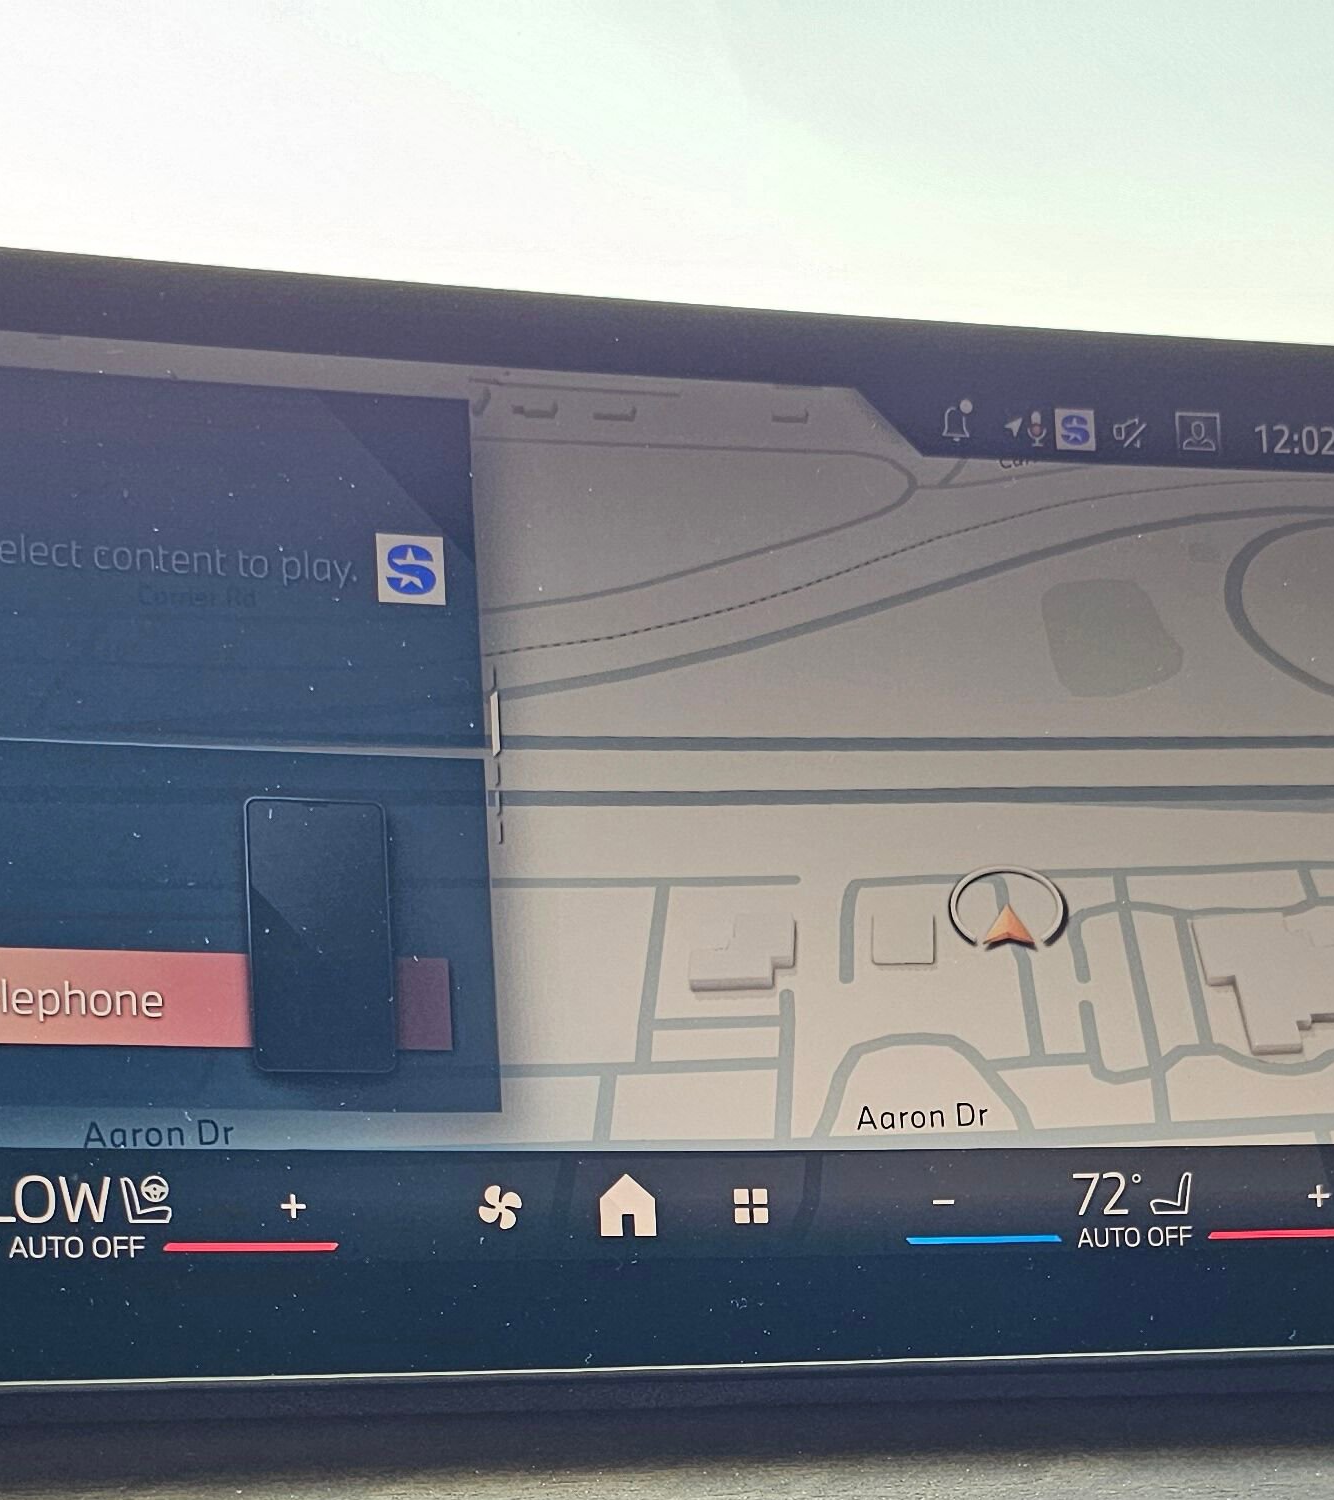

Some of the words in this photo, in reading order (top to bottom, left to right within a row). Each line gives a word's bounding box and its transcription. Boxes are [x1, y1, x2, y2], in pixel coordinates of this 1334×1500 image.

[93, 540, 227, 577] content
[238, 547, 269, 579] to
[282, 550, 357, 588] play.
[857, 1105, 945, 1131] Aaron
[956, 1103, 989, 1128] Dr
[83, 1121, 184, 1149] Aaron
[198, 1119, 235, 1146] Dr
[9, 1236, 85, 1259] AUTO
[92, 1236, 146, 1259] OFF
[1077, 1228, 1141, 1249] AUTO
[1148, 1226, 1193, 1247] OFF
